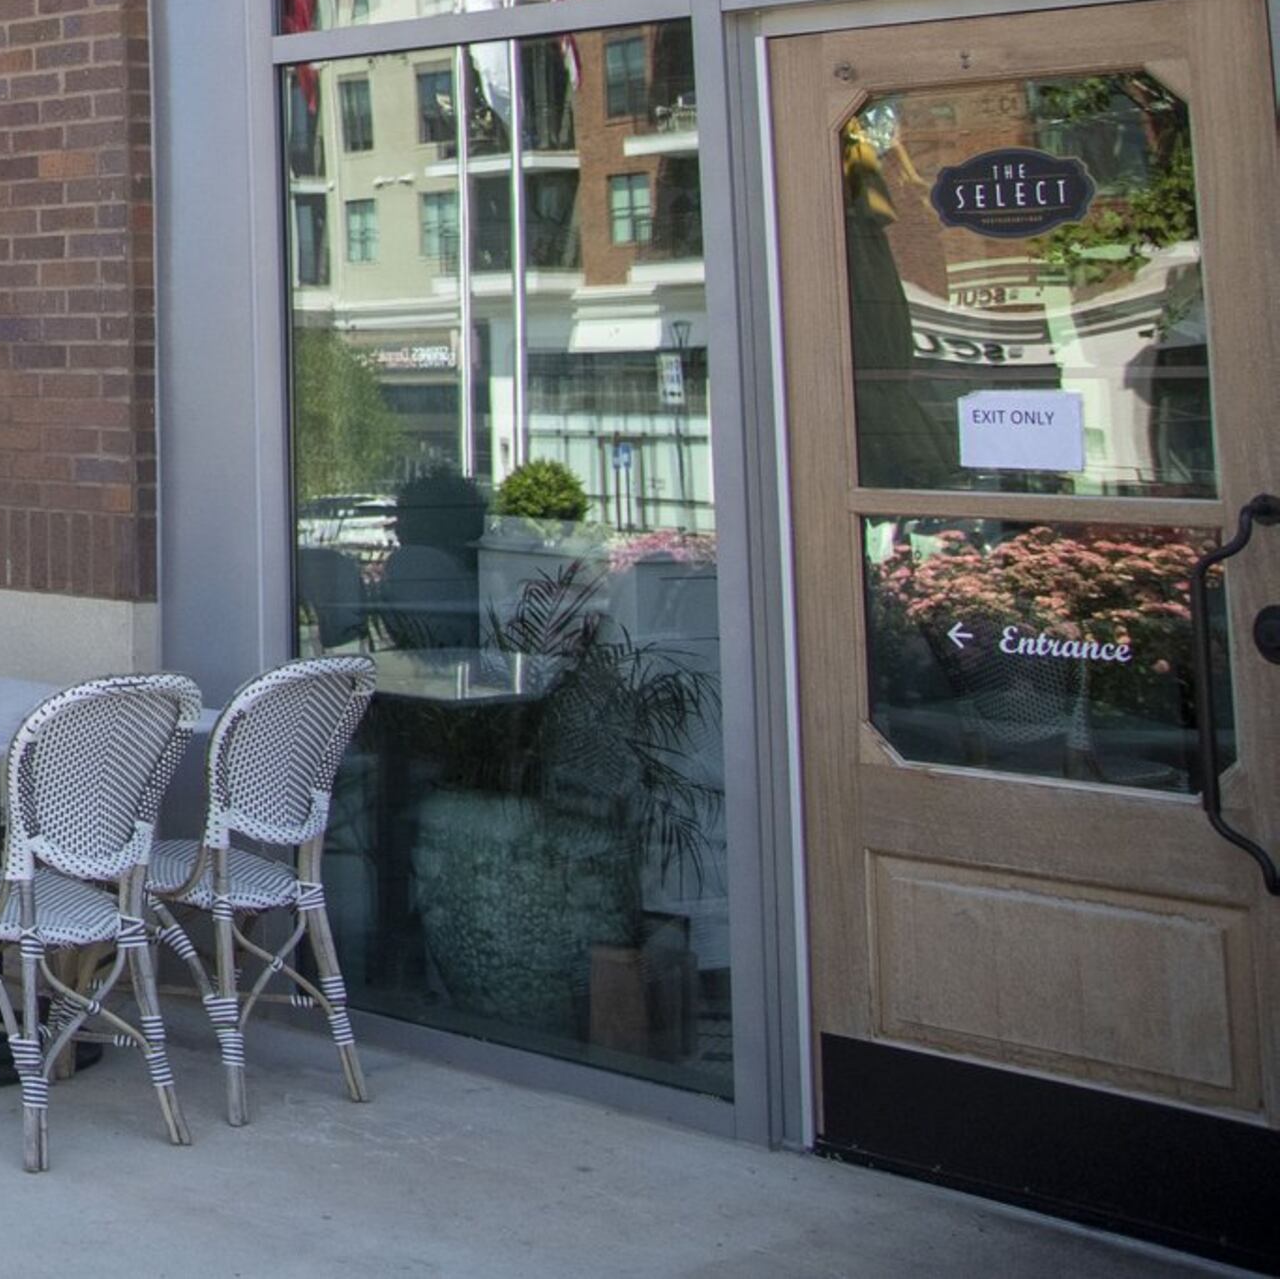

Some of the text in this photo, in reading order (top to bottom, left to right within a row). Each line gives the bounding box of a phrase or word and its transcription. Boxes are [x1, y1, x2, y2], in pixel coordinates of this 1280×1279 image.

[992, 163, 1027, 181] THE
[955, 180, 1066, 210] SELECT
[972, 409, 1055, 426] EXIT ONLY
[999, 625, 1133, 662] Entrance
